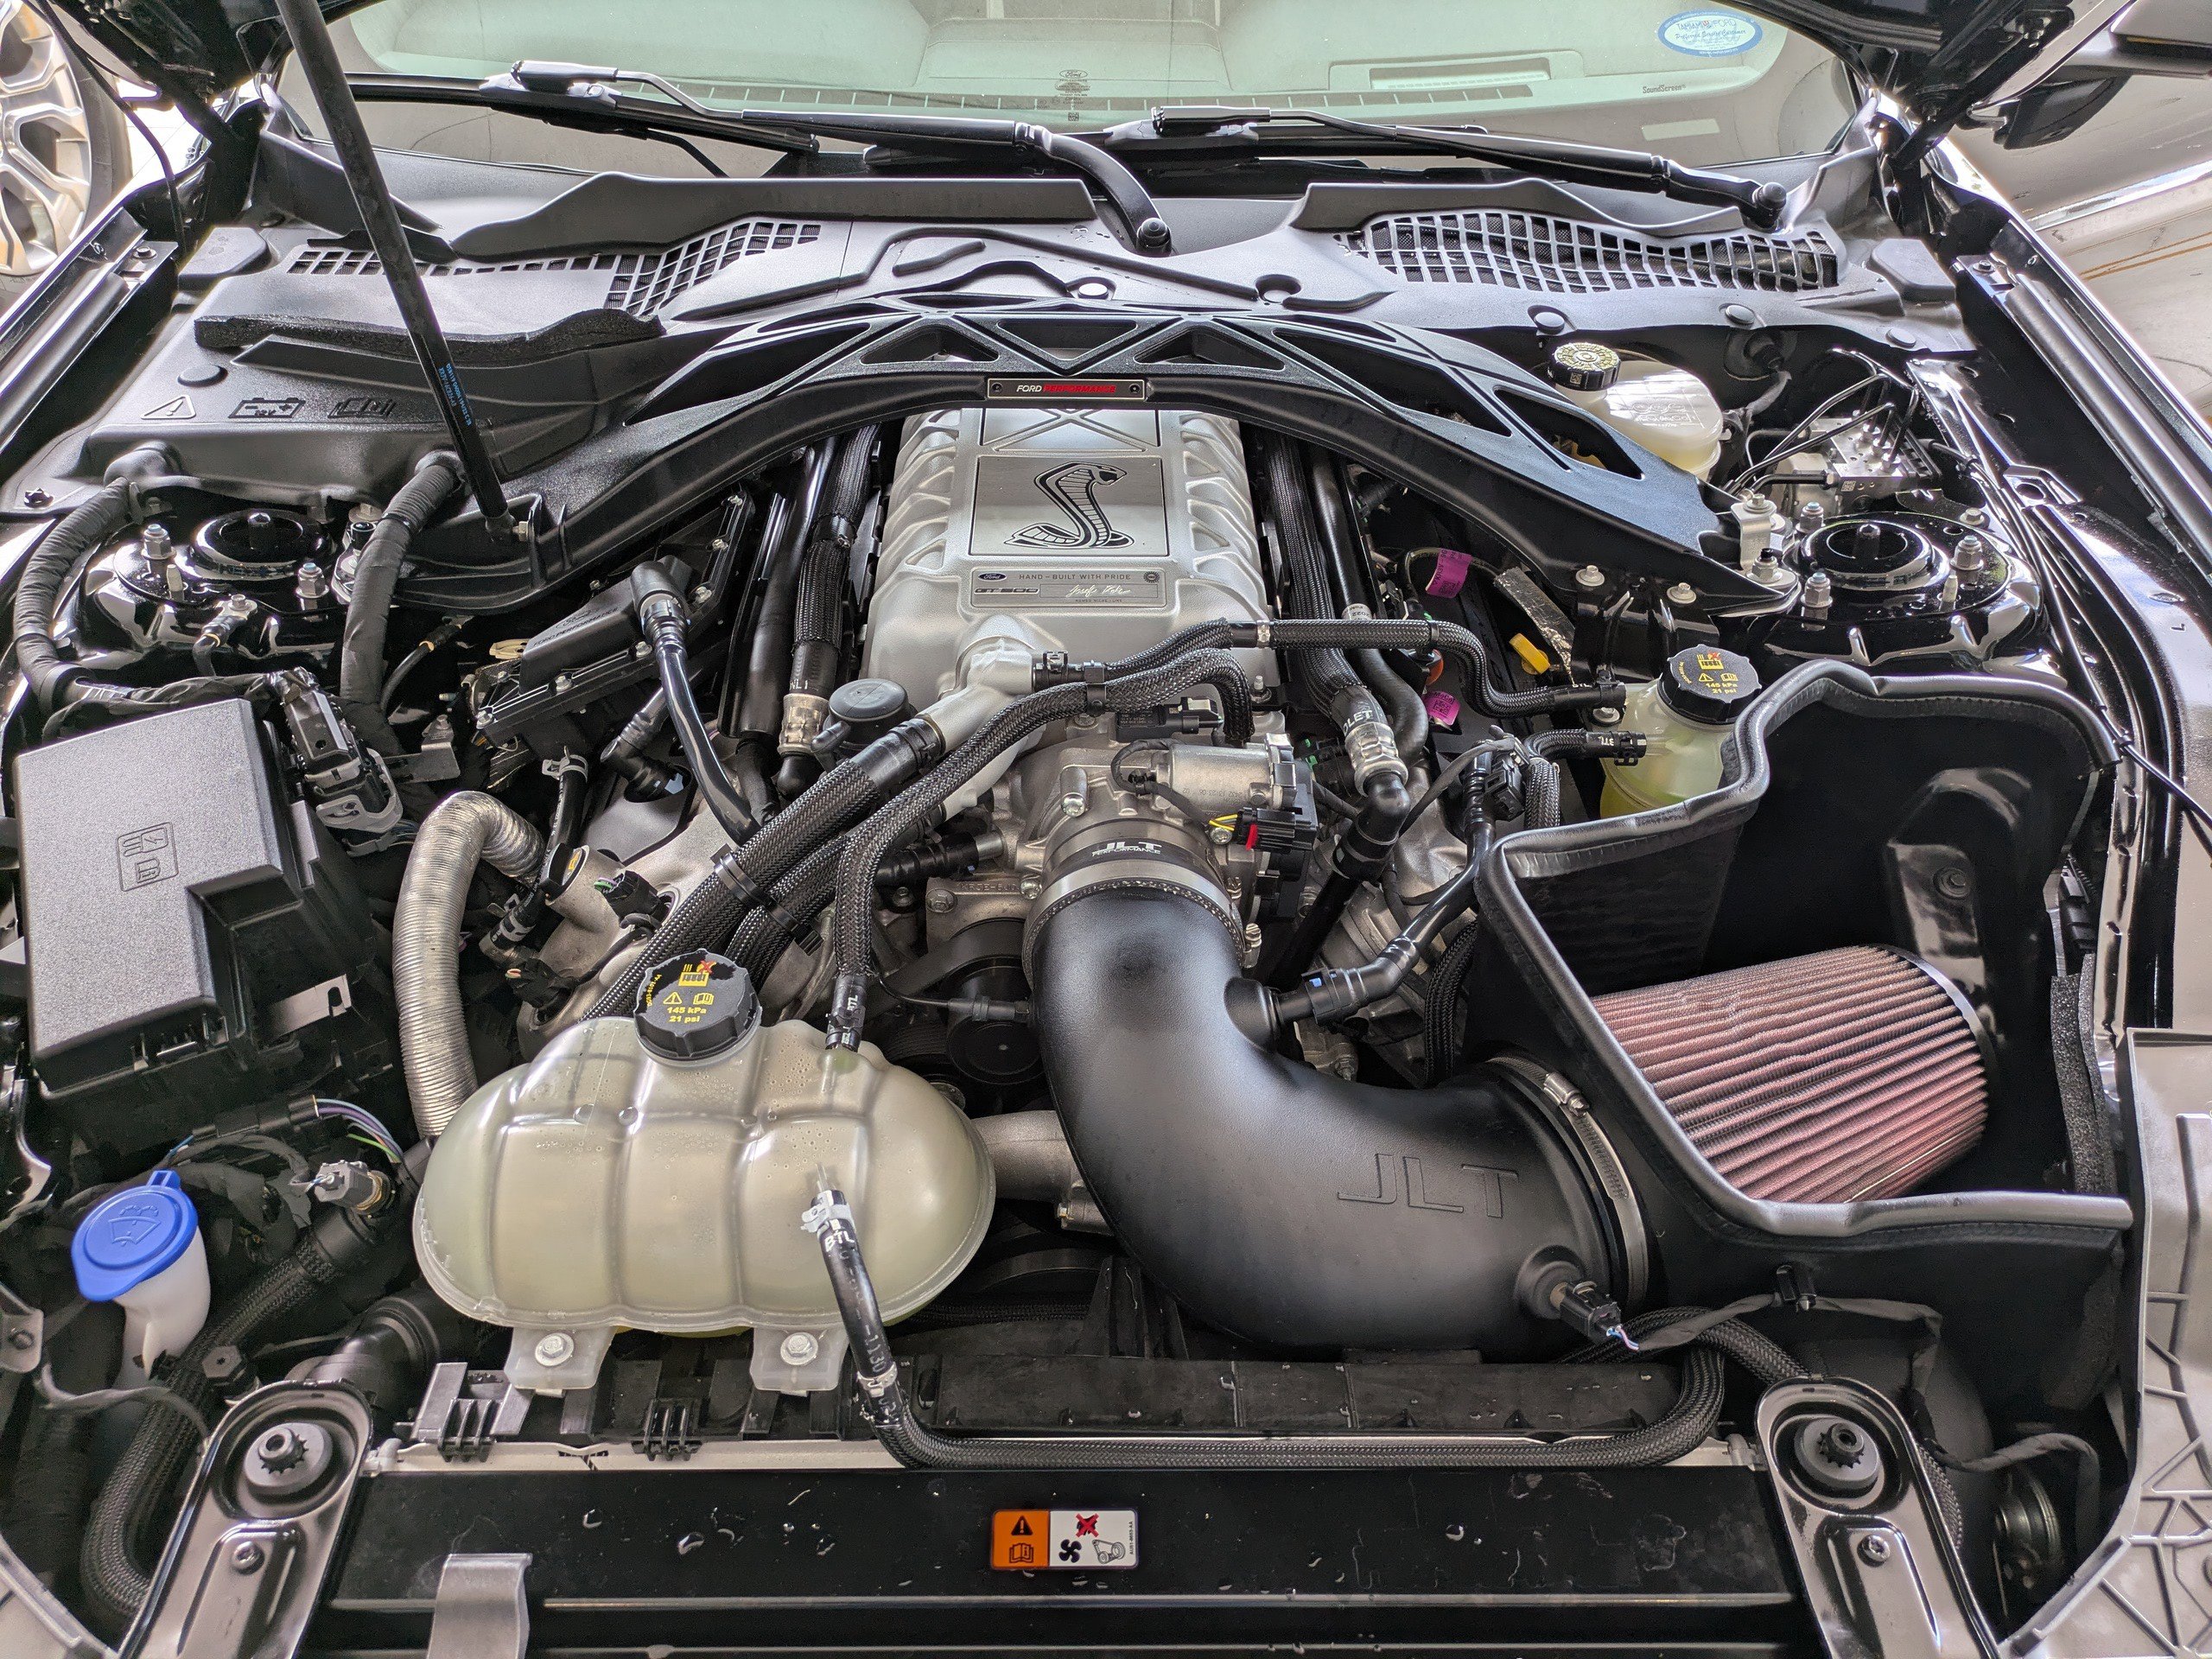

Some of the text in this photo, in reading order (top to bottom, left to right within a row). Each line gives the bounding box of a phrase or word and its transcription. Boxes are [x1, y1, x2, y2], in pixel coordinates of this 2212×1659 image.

[1042, 384, 1116, 393] PERFORMANCE
[1106, 841, 1162, 850] JLT
[1091, 847, 1161, 857] PERFORMANCE
[1337, 1154, 1519, 1219] JLT
